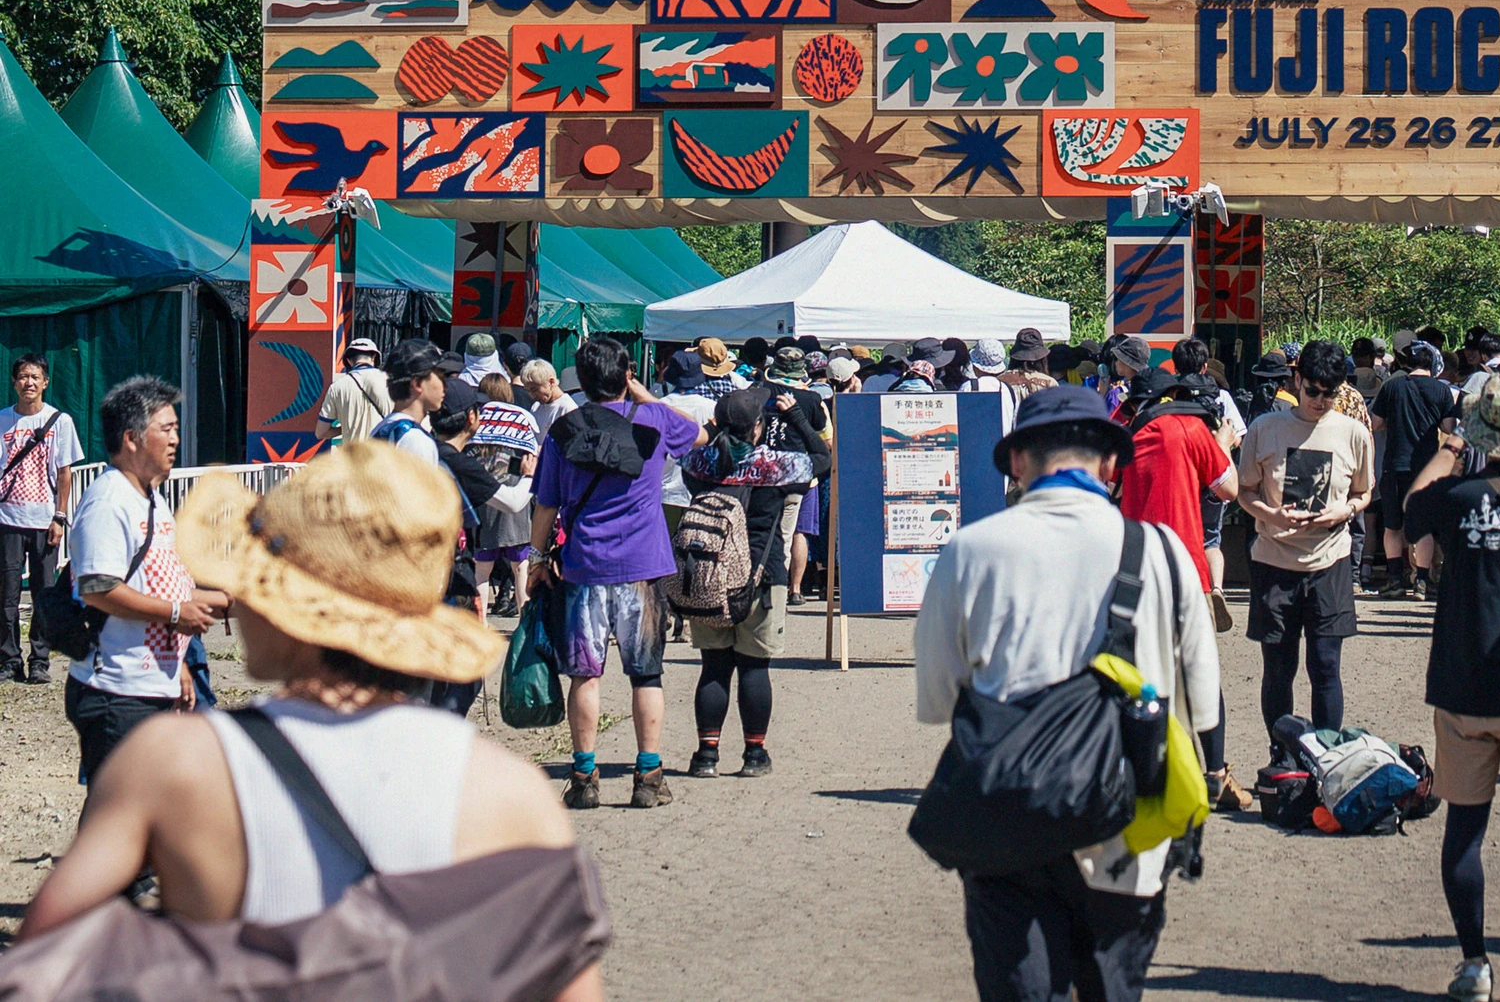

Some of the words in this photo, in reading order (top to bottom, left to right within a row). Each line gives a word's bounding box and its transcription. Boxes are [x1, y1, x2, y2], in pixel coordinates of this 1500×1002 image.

[1198, 6, 1345, 94] FUJI
[1236, 116, 1339, 146] JULY
[1346, 116, 1397, 145] 25
[1407, 116, 1457, 145] 26
[3, 429, 55, 442] STAF
